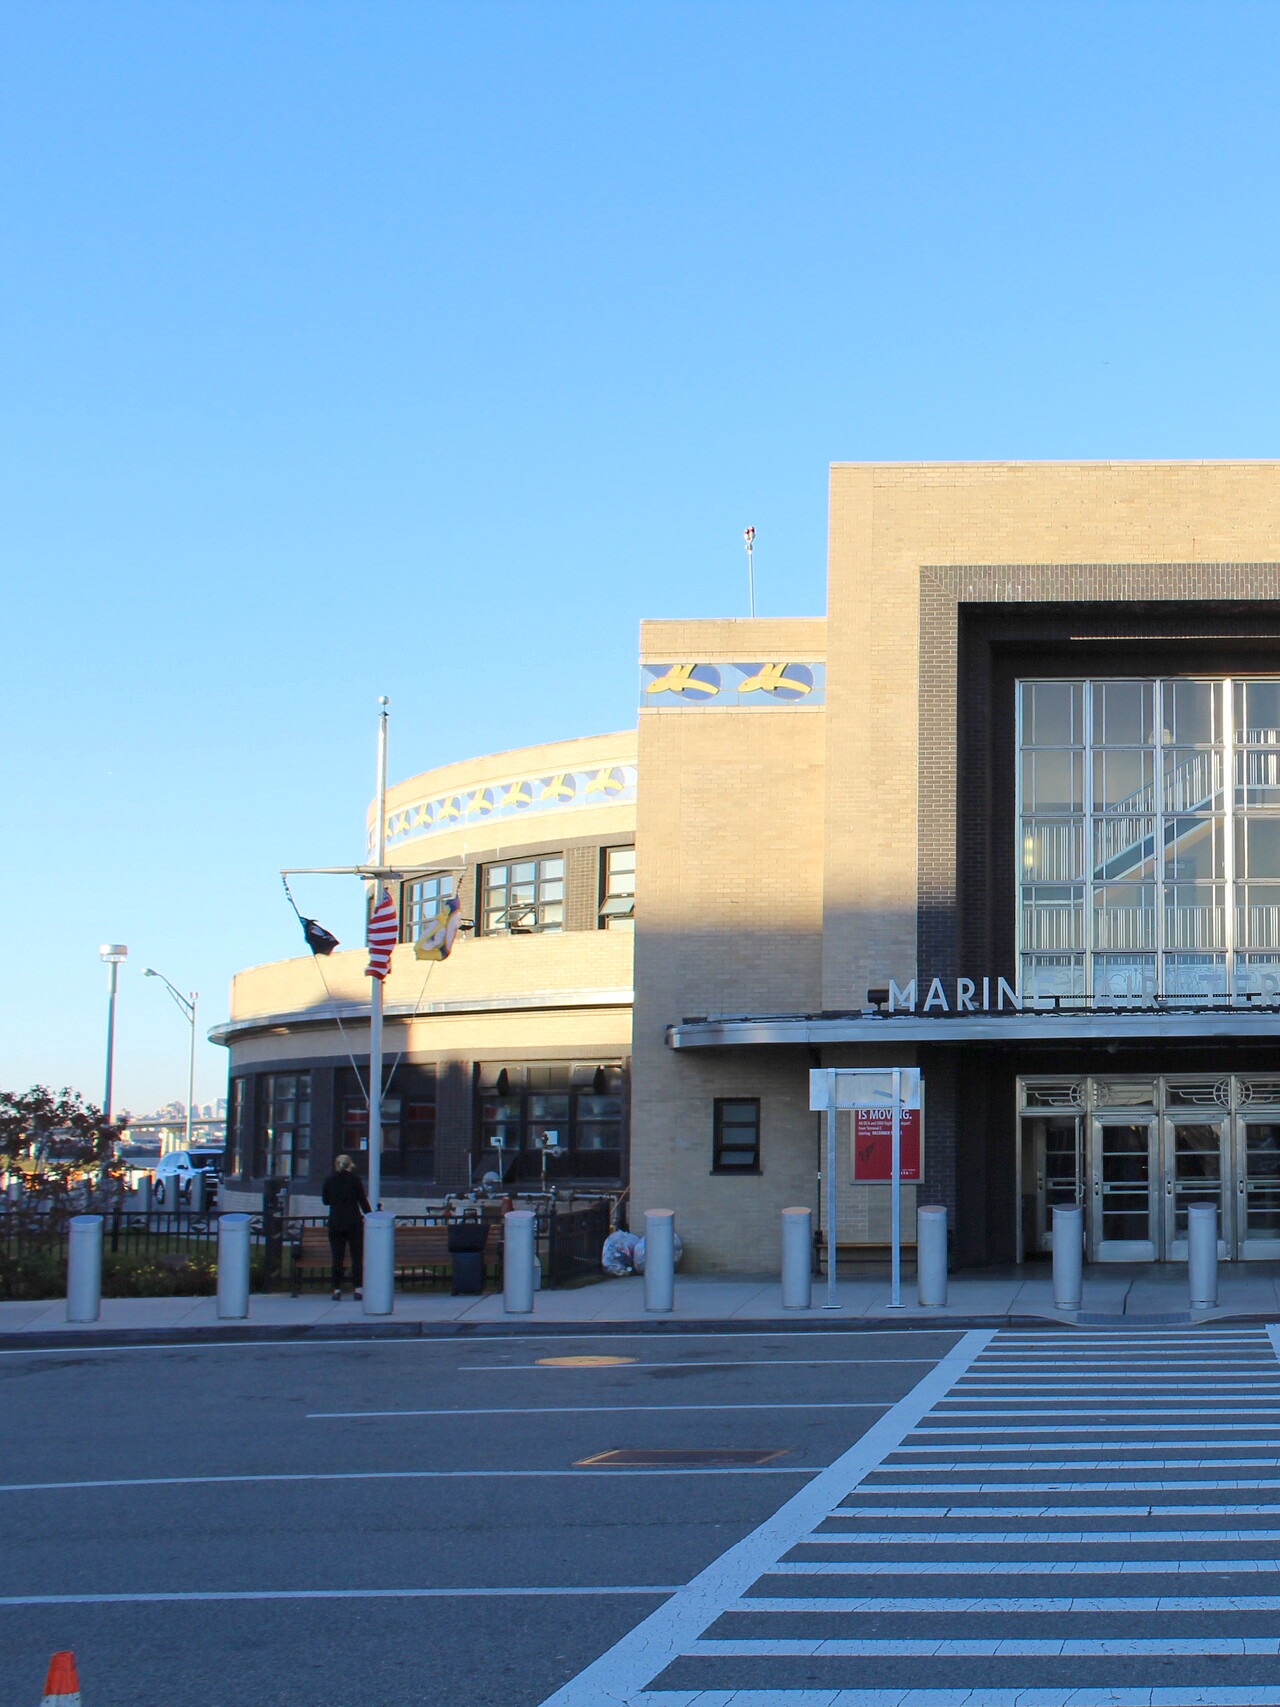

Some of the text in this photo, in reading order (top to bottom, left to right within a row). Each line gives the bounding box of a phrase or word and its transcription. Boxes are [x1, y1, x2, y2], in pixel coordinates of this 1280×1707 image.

[888, 976, 1056, 1012] MARINE
[1091, 974, 1161, 1009] AIR
[858, 1110, 912, 1120] IS MOVG.
